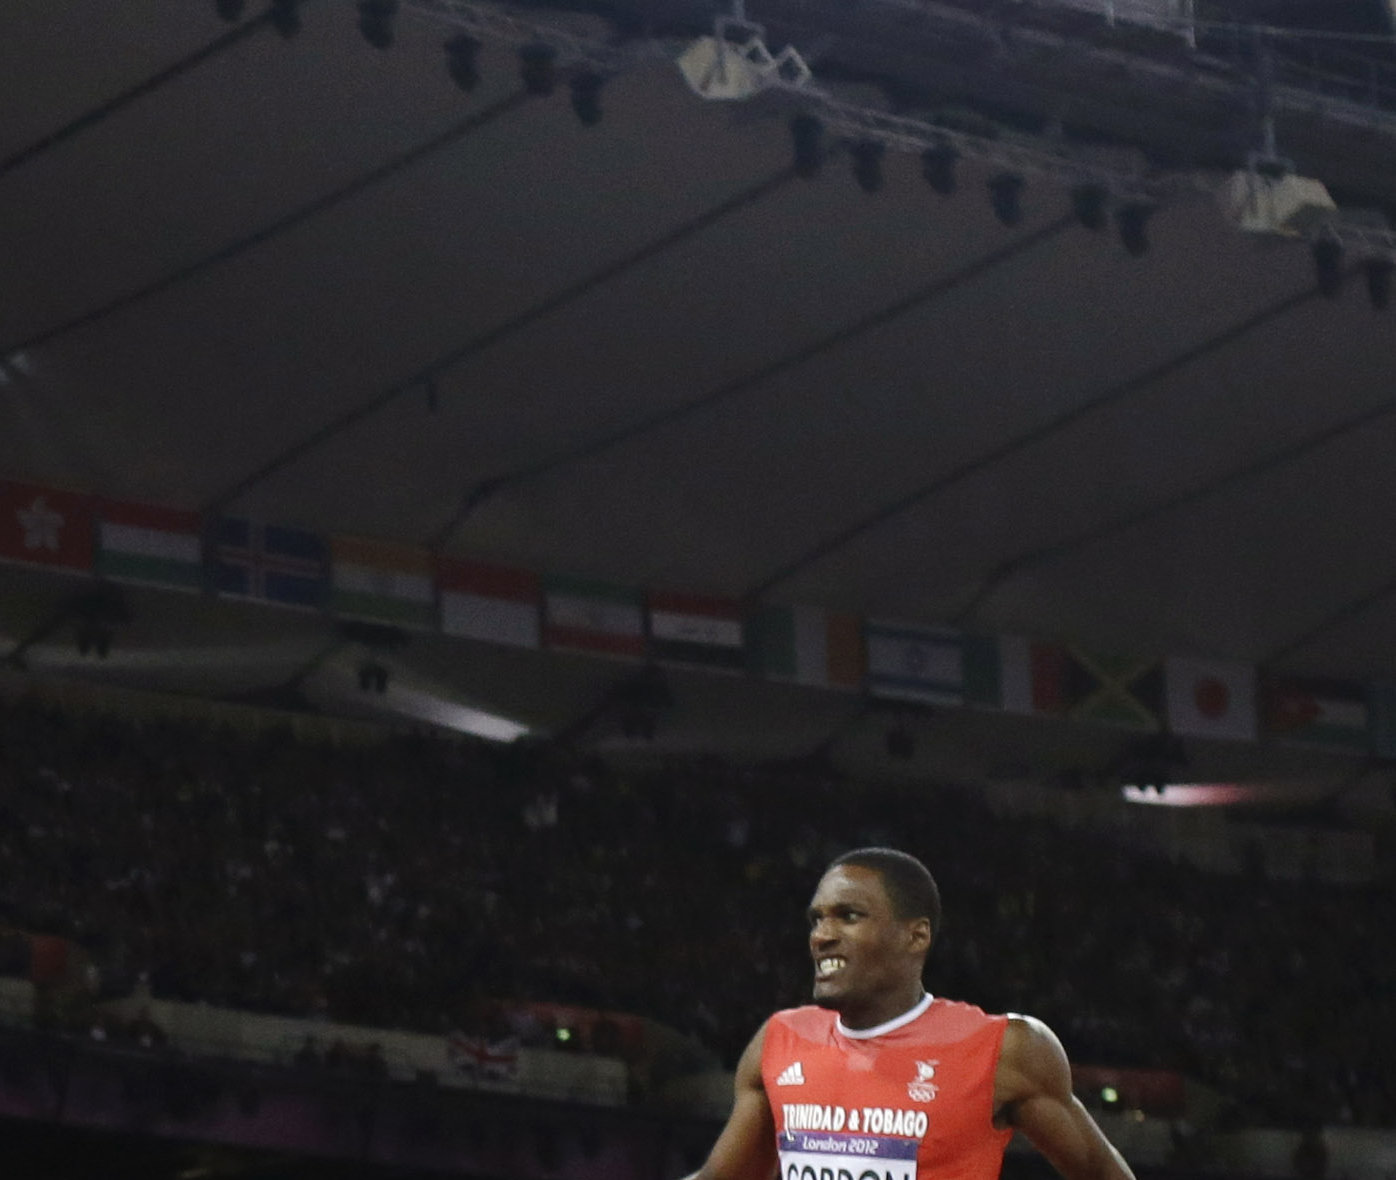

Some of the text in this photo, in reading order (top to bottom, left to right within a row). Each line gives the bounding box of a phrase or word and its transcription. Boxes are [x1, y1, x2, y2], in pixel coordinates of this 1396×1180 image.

[782, 1103, 929, 1138] TRINIDAD & TOBAGO
[802, 1135, 879, 1155] London 2012
